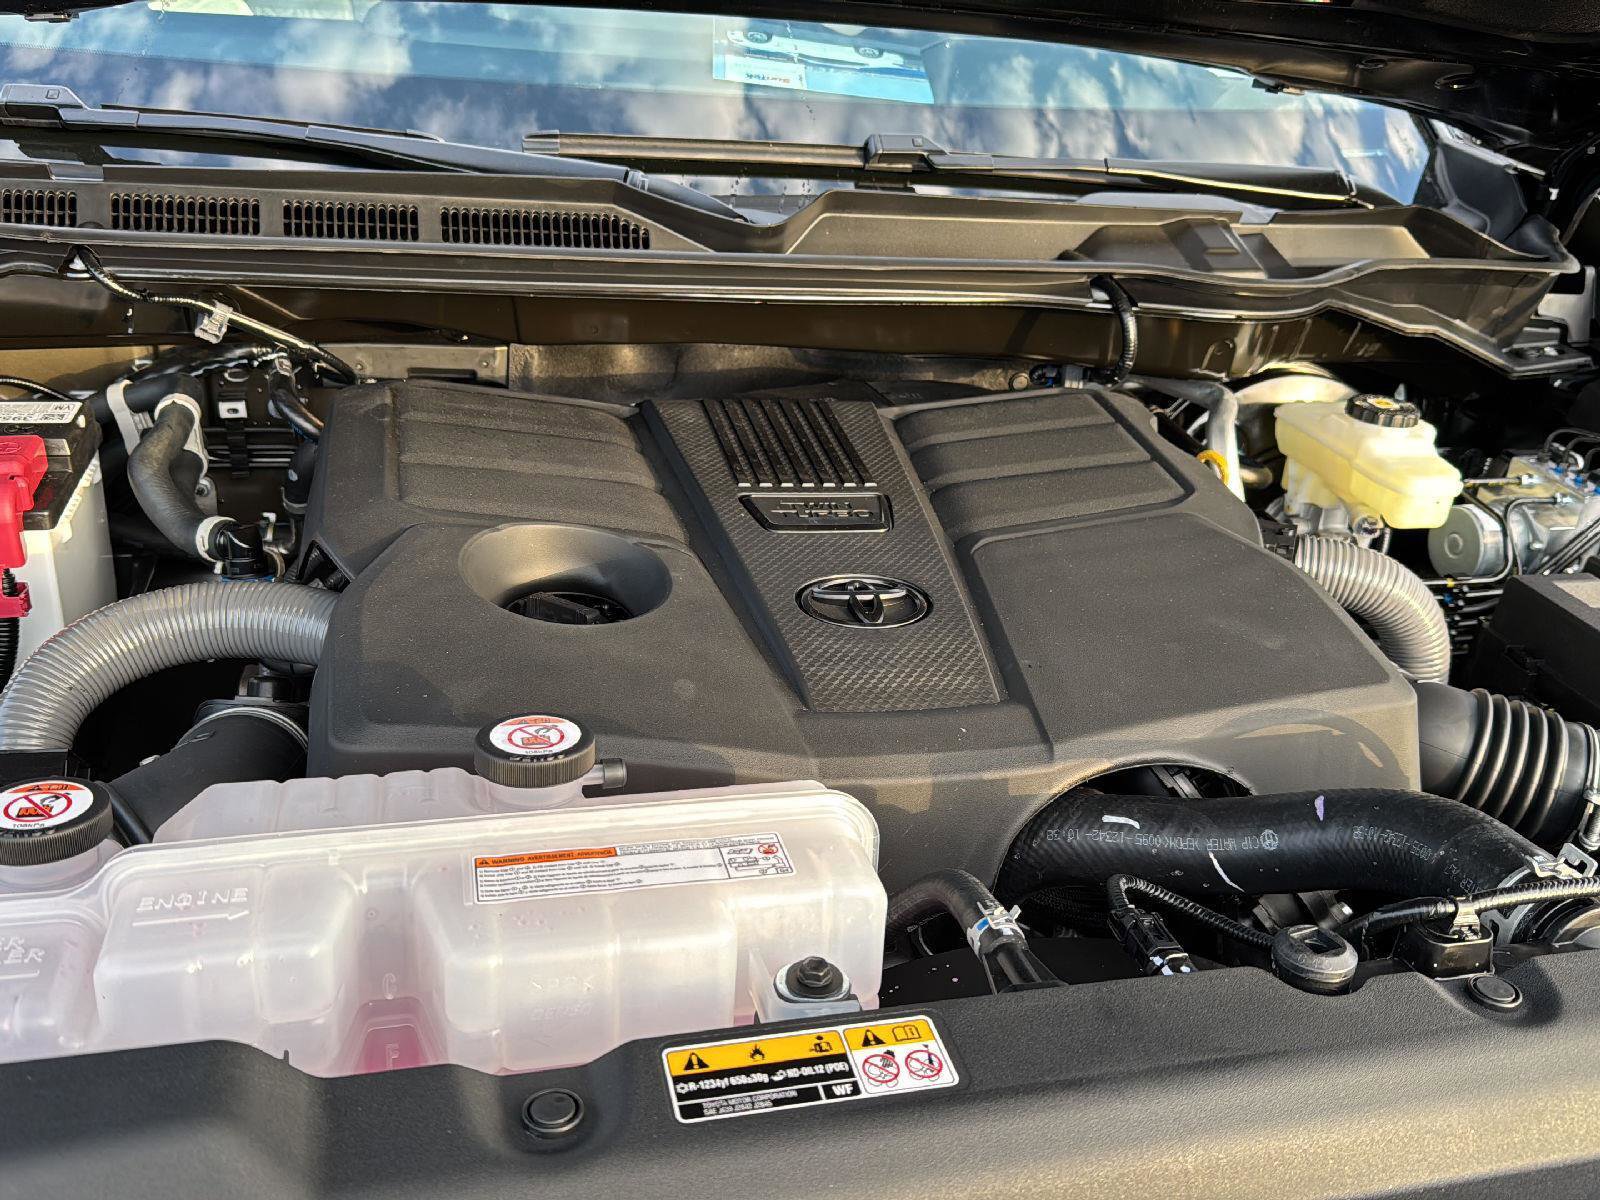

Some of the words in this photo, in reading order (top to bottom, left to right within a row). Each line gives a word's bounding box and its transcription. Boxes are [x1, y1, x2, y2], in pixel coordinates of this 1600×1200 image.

[1206, 838, 1237, 850] WATER
[491, 857, 525, 865] WARNING
[136, 887, 249, 912] ENGINE
[688, 1076, 729, 1092] R-1234yf
[832, 1083, 854, 1096] WF
[702, 1099, 728, 1108] TOYOTA
[728, 1096, 752, 1105] MOTOR
[752, 1090, 798, 1101] CORPORATION
